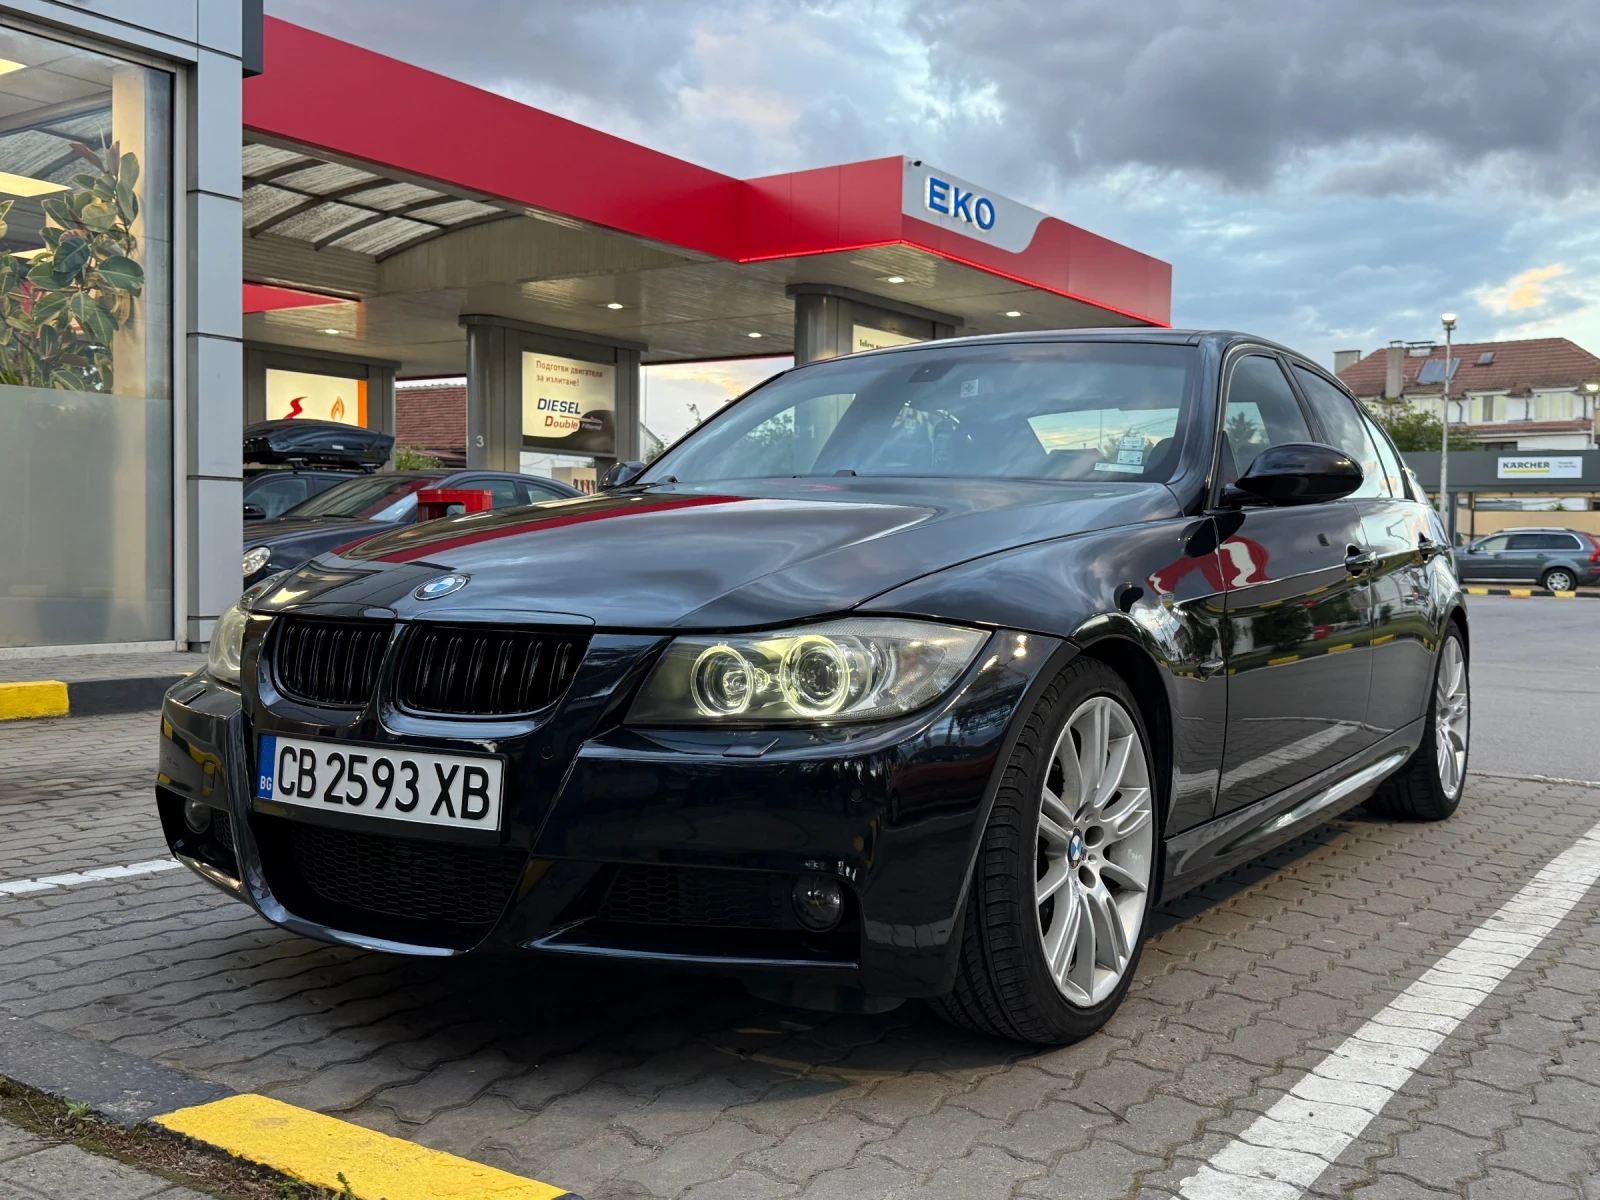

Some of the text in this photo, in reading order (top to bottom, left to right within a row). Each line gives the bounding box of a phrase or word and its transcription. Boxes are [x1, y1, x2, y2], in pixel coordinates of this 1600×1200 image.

[925, 177, 995, 231] EKO
[536, 360, 603, 378] Подготви двигателя
[536, 374, 580, 386] за излитане!
[537, 398, 581, 415] DIESEL
[544, 415, 579, 430] Double
[476, 435, 484, 448] 3
[259, 775, 272, 791] BG
[278, 744, 490, 821] CB 2593 XB
